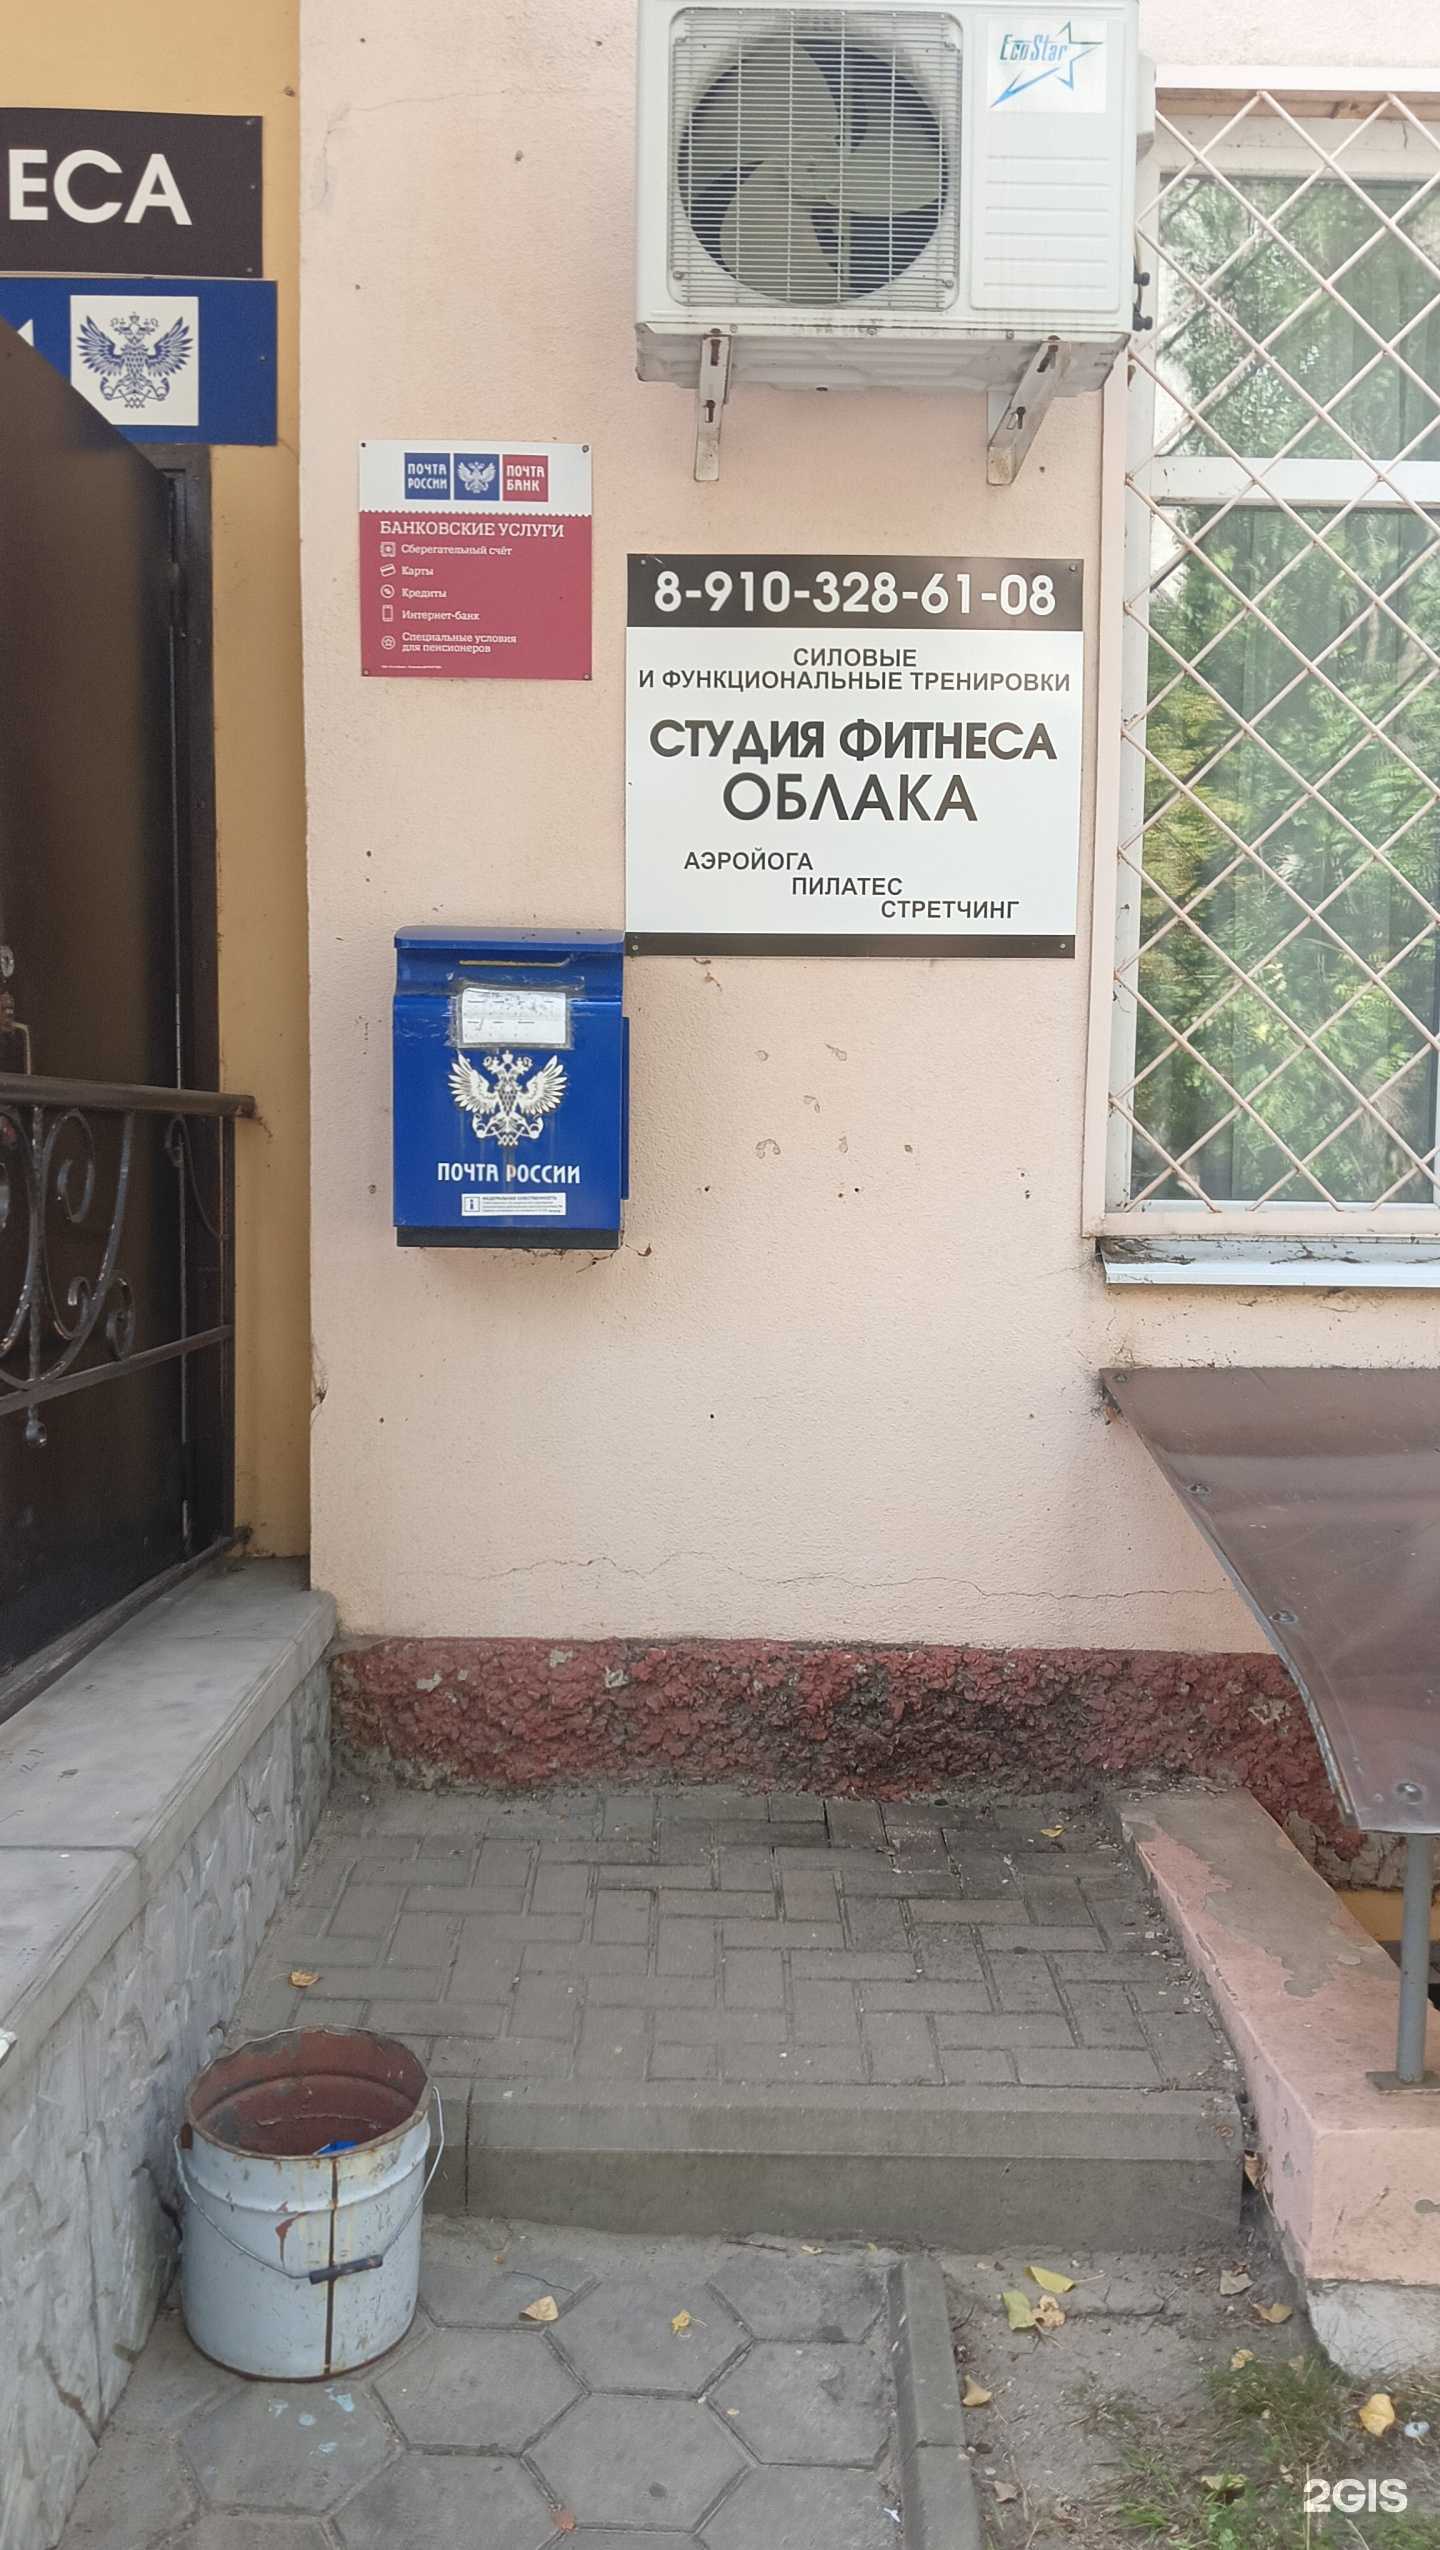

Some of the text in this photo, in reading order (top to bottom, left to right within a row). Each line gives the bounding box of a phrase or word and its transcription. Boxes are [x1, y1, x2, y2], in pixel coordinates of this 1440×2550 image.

[1000, 33, 1068, 61] EcoStar
[8, 148, 193, 226] ЕСА
[407, 463, 447, 475] ПОЧТА
[506, 465, 545, 478] ПОЧТА
[407, 477, 448, 489] РОССИИ
[506, 480, 541, 492] БАНК
[380, 521, 565, 538] БАНКОВСКИЕ УСЛУГИ
[401, 543, 487, 556] Сберегательный
[401, 566, 434, 577] Карты
[401, 588, 447, 599] Кредиты
[654, 570, 1057, 616] 8-910-328-61-08
[401, 609, 480, 622] Интернет-банк
[401, 632, 517, 644] Специальные условия
[401, 644, 492, 655] для пенсионеров
[793, 648, 917, 667] СИЛОВЫЕ
[639, 670, 1070, 692] И ФУНКЦИОНАЛЬНЫЕ ТРЕНИРОВКИ
[649, 718, 1058, 764] СТУДИЯ ФИТНЕСА
[723, 772, 978, 821] ОБЛАКА
[684, 847, 813, 870] АЭРОЙОГА
[791, 877, 903, 896] ПИЛАТЕС
[881, 900, 1020, 919] СТРЕТЧИНГ
[437, 1162, 580, 1184] ПОЧТА РОССИИ
